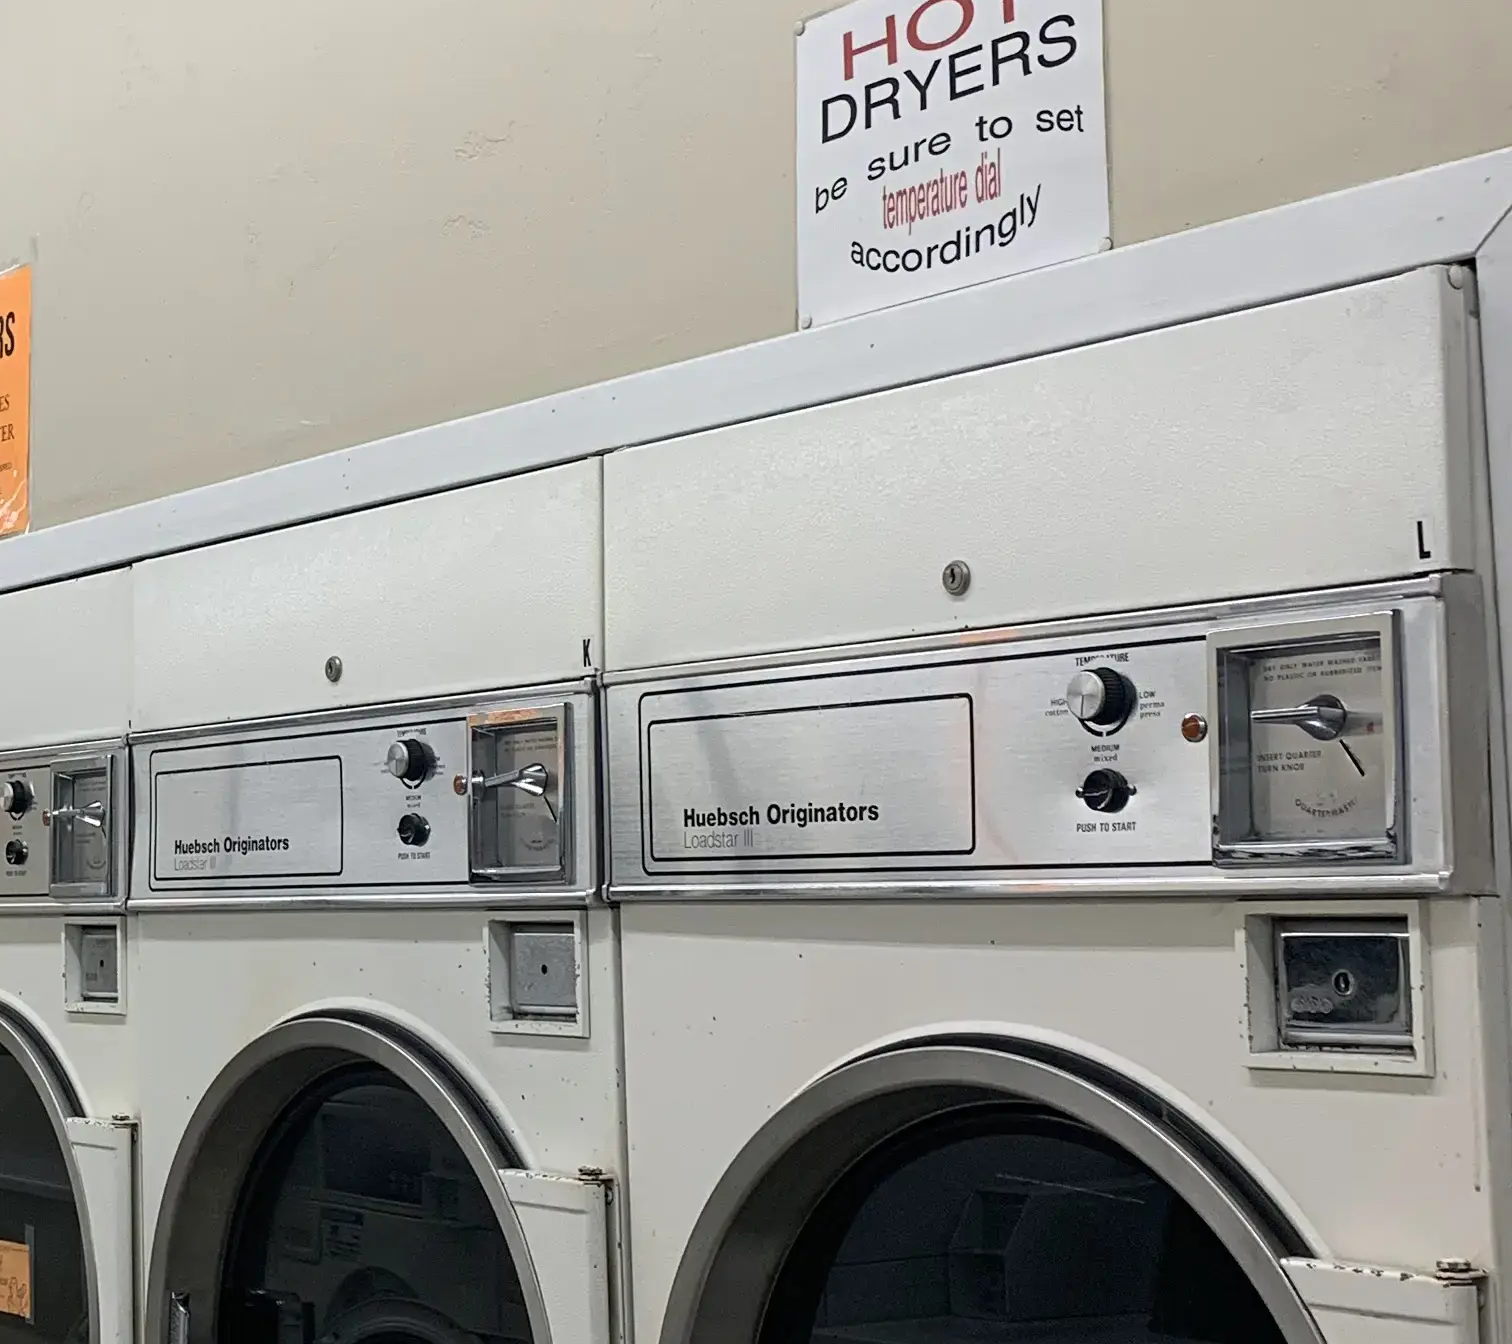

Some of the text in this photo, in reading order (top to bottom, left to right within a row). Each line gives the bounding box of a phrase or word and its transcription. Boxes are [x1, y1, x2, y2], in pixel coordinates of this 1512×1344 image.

[821, 14, 1077, 144] DRYERS
[815, 104, 1084, 214] be sure to set
[882, 147, 1001, 236] temperature dial
[850, 183, 1041, 273] accordingly
[1416, 520, 1431, 560] L
[582, 638, 592, 668] K
[1139, 690, 1156, 699] LOW
[1139, 701, 1165, 710] perma
[1091, 744, 1120, 752] MEDIUM
[1285, 750, 1321, 760] QUARTER
[1093, 754, 1118, 762] mixed
[1257, 763, 1305, 773] TURN KNOB
[683, 802, 880, 828] Huebsch Originators
[1076, 821, 1136, 833] PUSH TO START
[174, 835, 290, 856] Huebsch Originators
[683, 831, 738, 849] Loadstar
